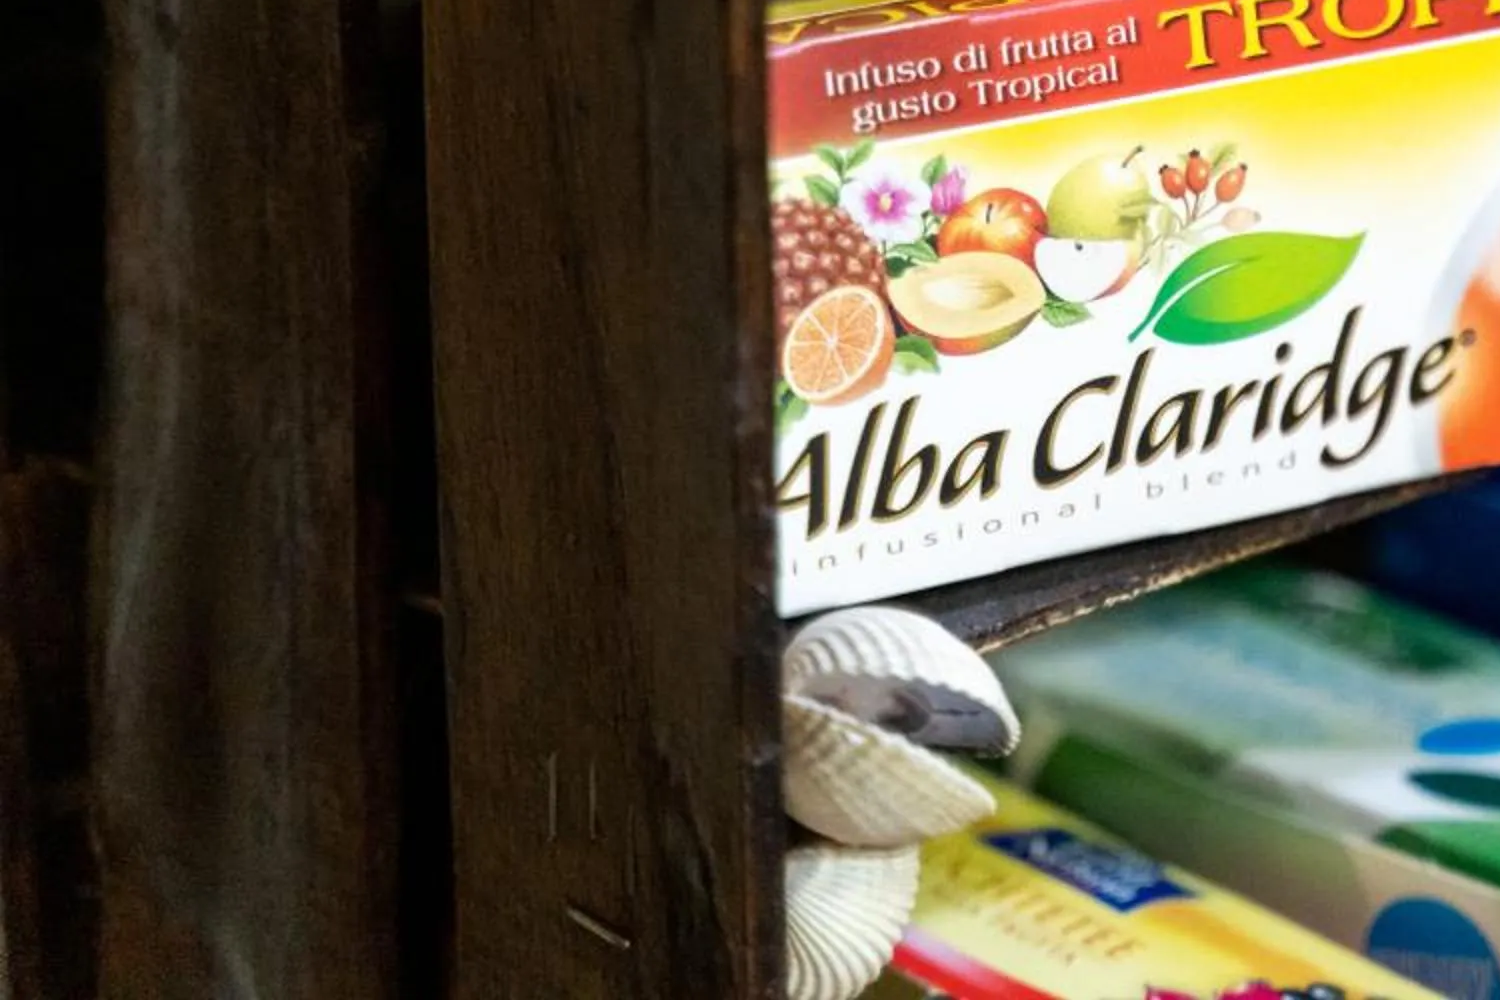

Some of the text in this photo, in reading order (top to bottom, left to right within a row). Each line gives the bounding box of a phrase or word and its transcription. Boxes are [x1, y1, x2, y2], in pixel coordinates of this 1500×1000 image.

[823, 16, 1138, 98] Infuso di frutta al
[851, 55, 1120, 133] gusto Tropical
[774, 395, 1011, 542] Alba
[791, 452, 1299, 577] infusional blend
